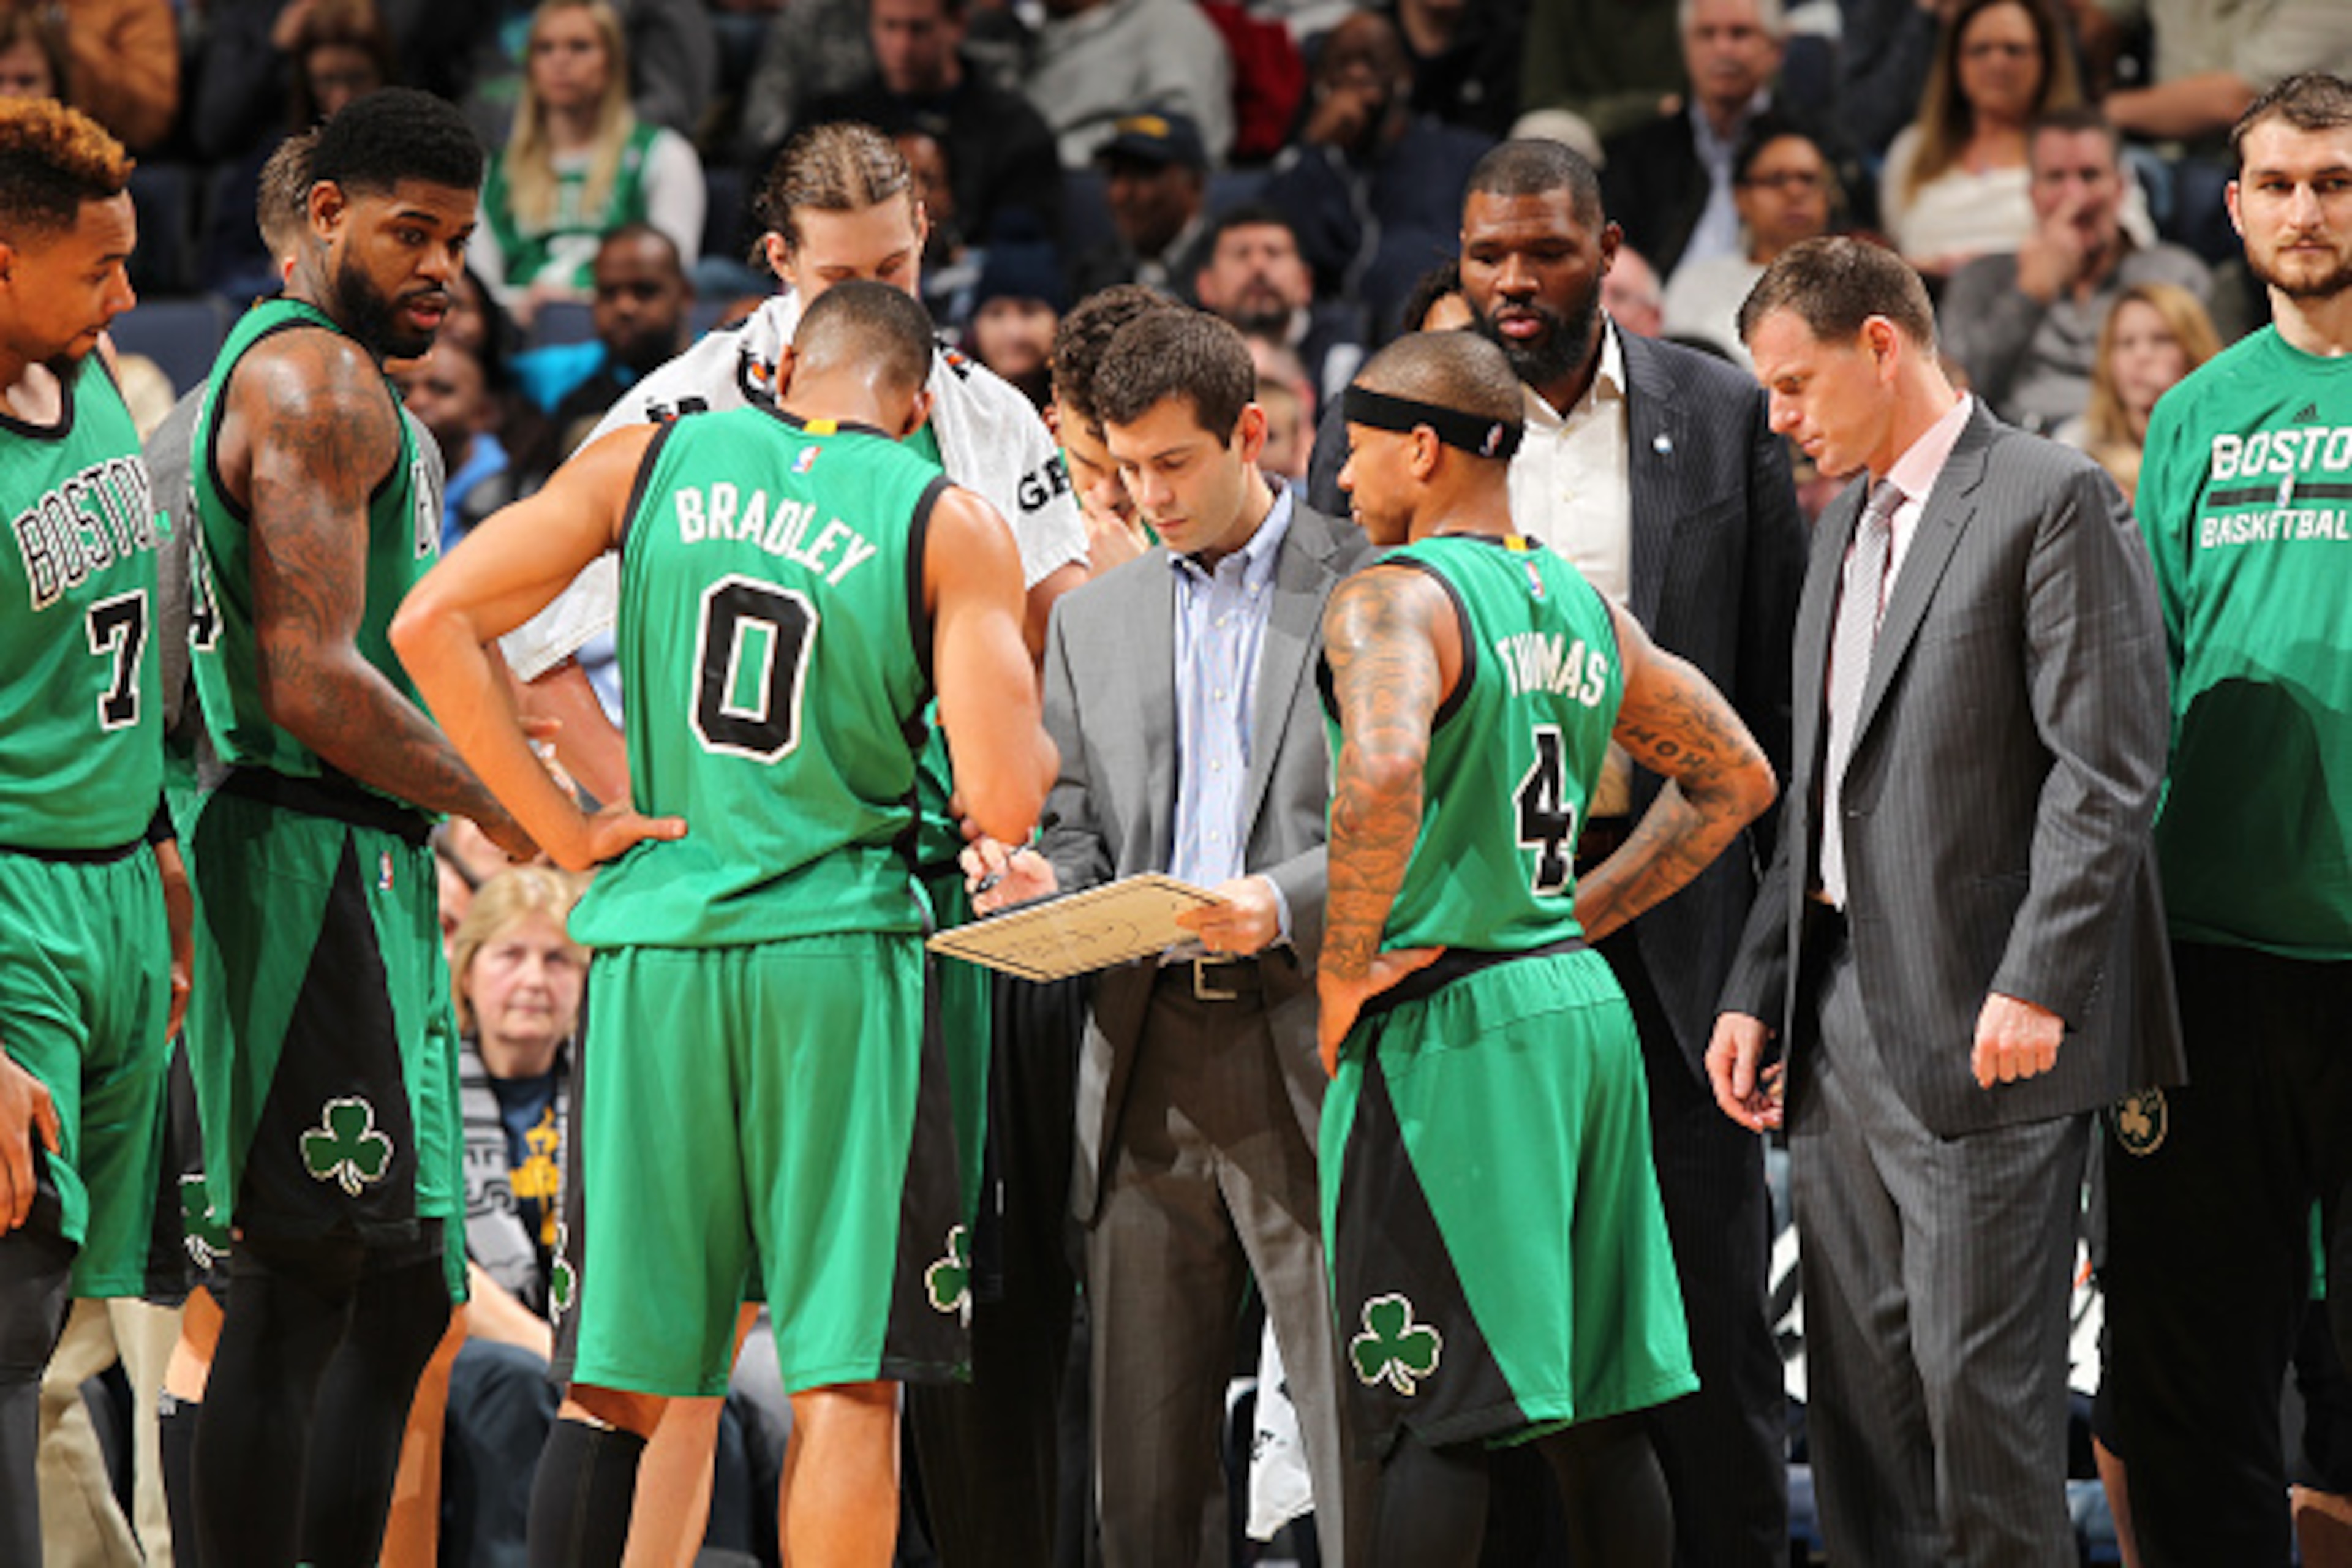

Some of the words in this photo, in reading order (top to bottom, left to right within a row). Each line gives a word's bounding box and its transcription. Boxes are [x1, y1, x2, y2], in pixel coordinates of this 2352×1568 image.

[674, 481, 878, 588] BRADLEY
[86, 588, 148, 729] 7
[688, 572, 821, 764] 0
[1494, 631, 1608, 709] THOMAS
[1512, 723, 1577, 897] 4
